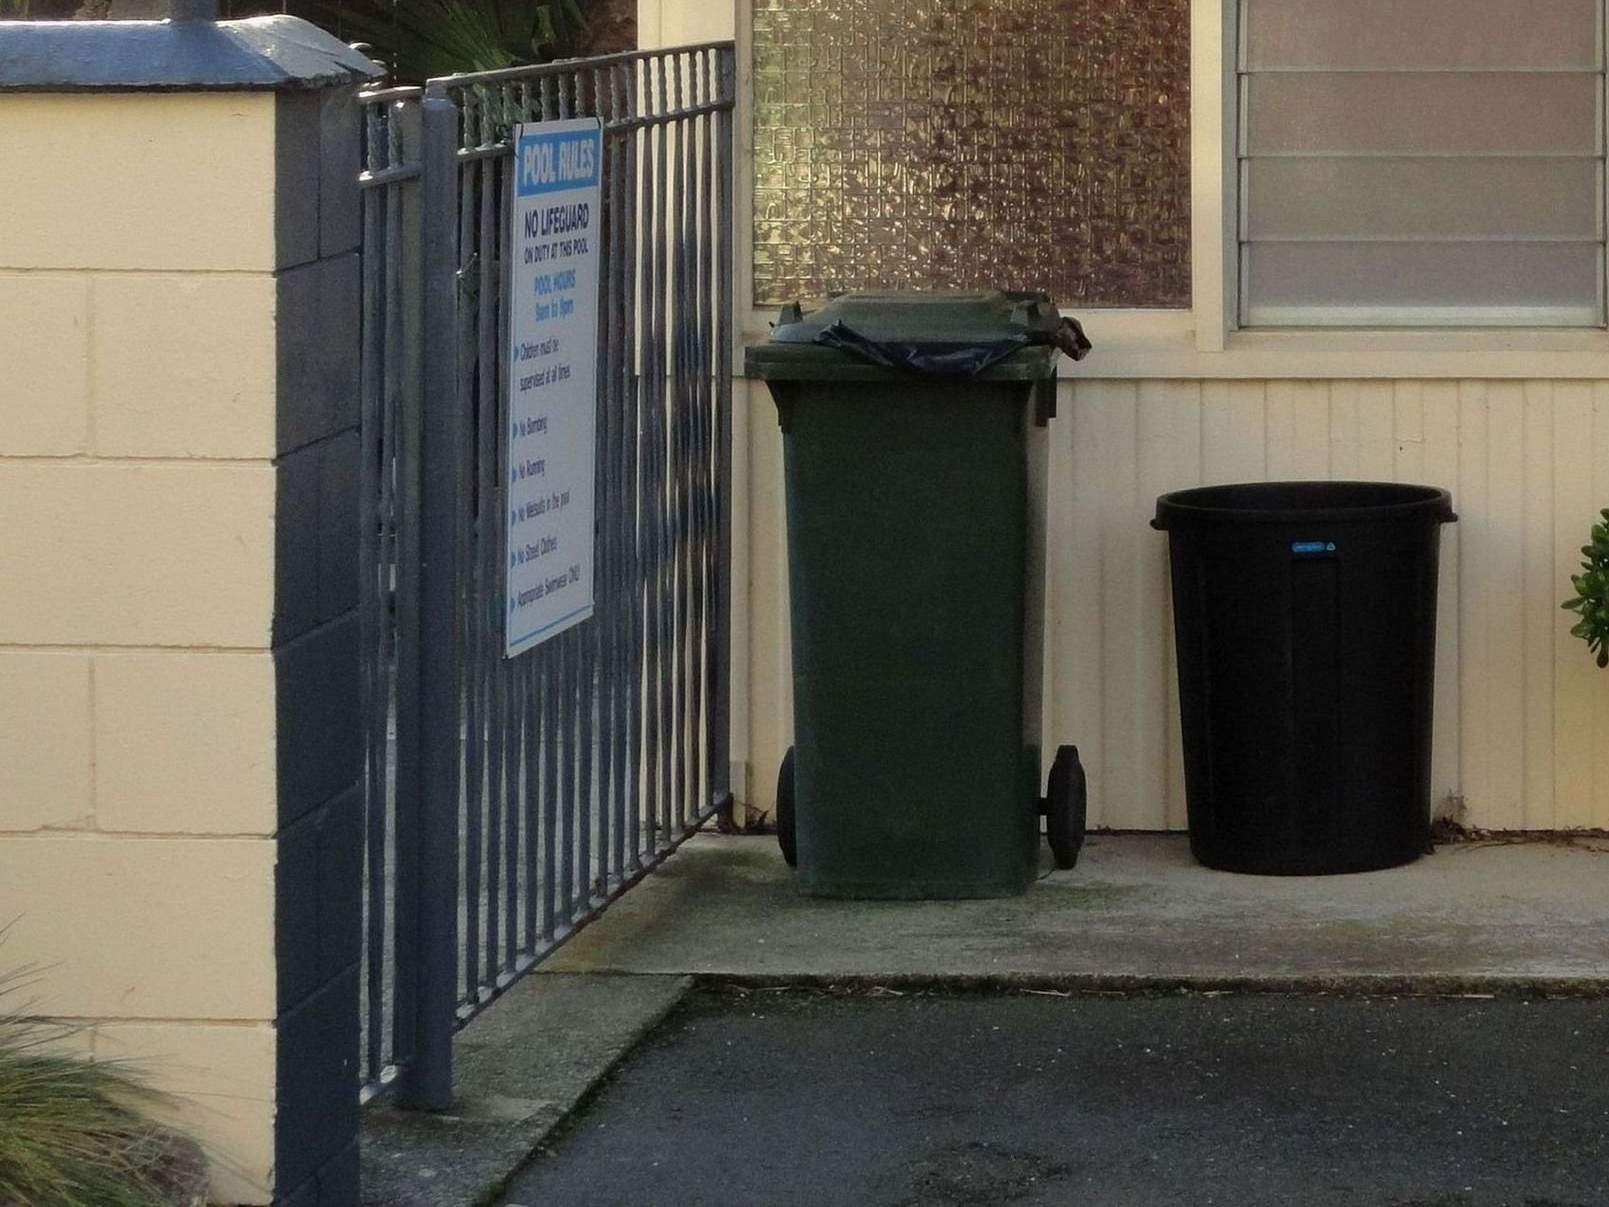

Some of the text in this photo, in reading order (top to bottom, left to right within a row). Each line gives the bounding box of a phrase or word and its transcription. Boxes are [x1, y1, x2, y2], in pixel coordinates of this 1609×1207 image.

[524, 139, 594, 186] POOL RULES
[525, 202, 589, 239] NO LIFEGUARD
[534, 244, 550, 263] DUTY
[551, 242, 558, 260] AT
[559, 240, 573, 258] THIS
[573, 237, 588, 257] POOL
[534, 269, 576, 296] POOL HOURS
[520, 342, 539, 361] Children
[519, 371, 545, 393] supervised
